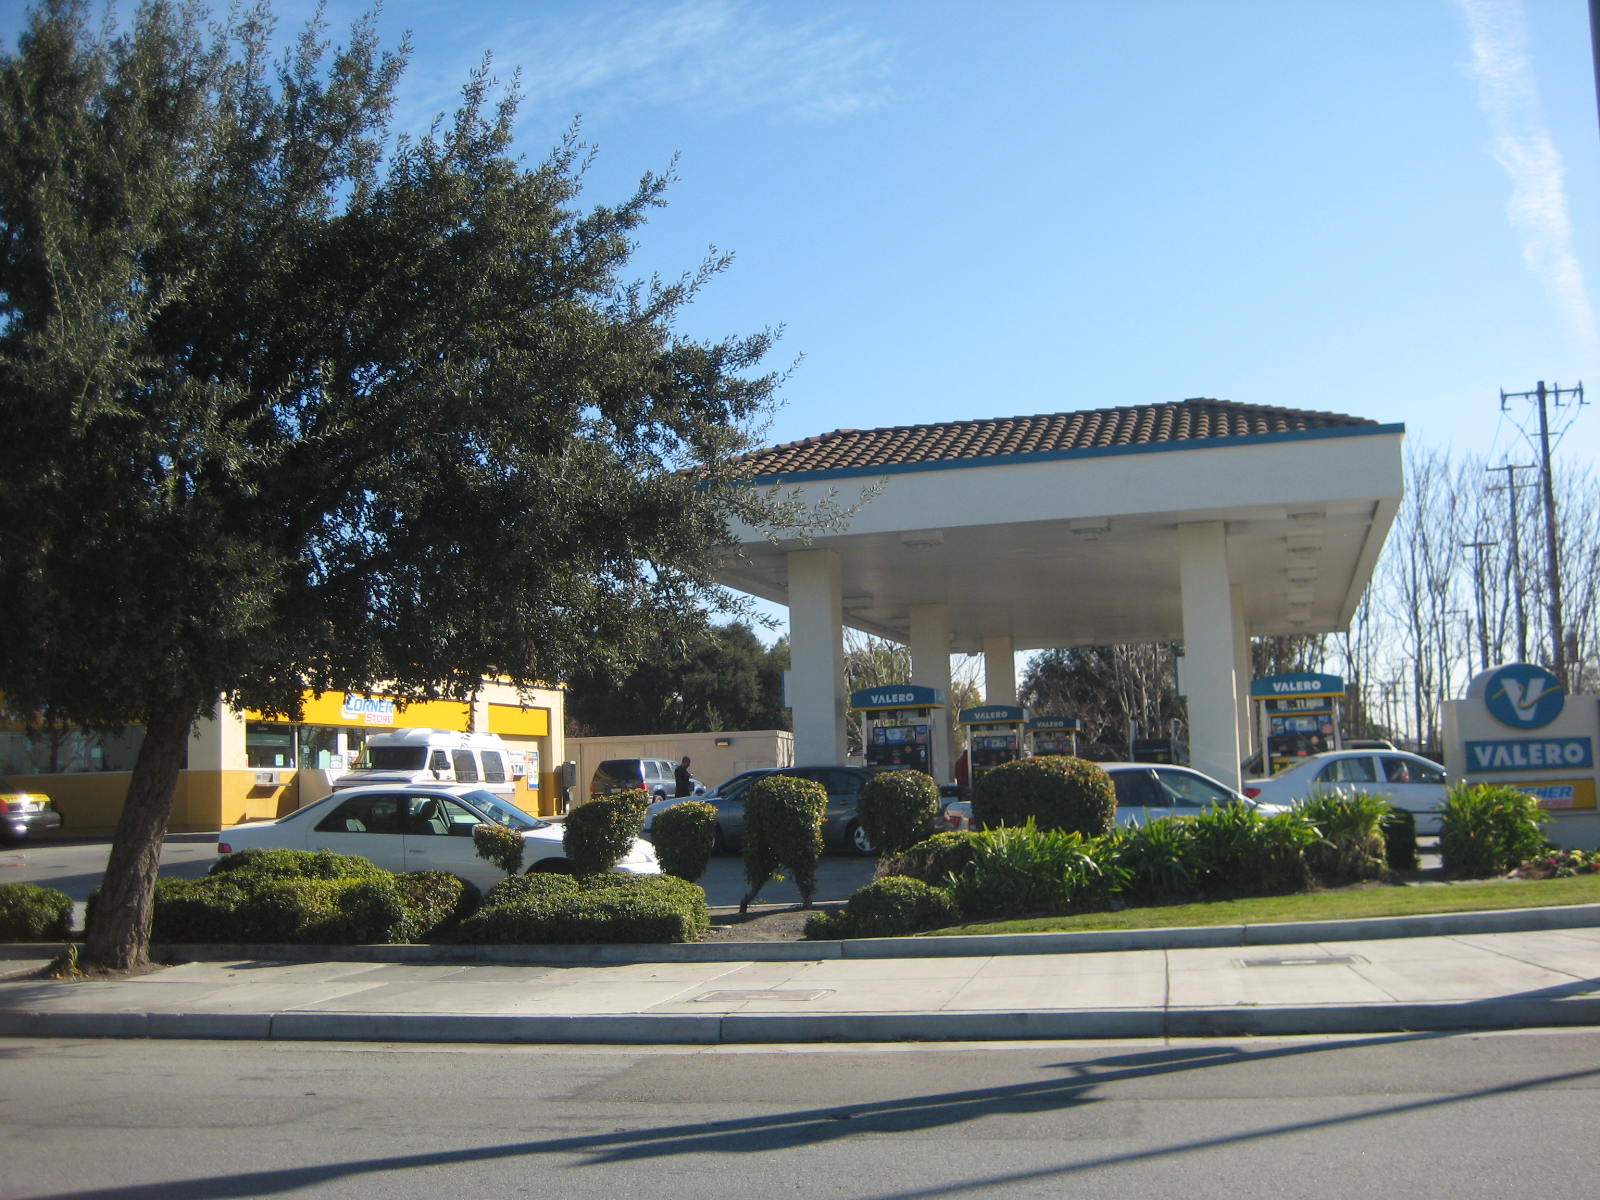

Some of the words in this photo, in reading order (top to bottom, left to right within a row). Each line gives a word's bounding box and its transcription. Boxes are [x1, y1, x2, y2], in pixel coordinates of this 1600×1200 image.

[1272, 680, 1321, 692] VALERO
[345, 695, 393, 713] CORNER
[870, 693, 915, 704] VALERO
[974, 711, 1008, 719] VALERO
[1473, 743, 1585, 767] VALERO
